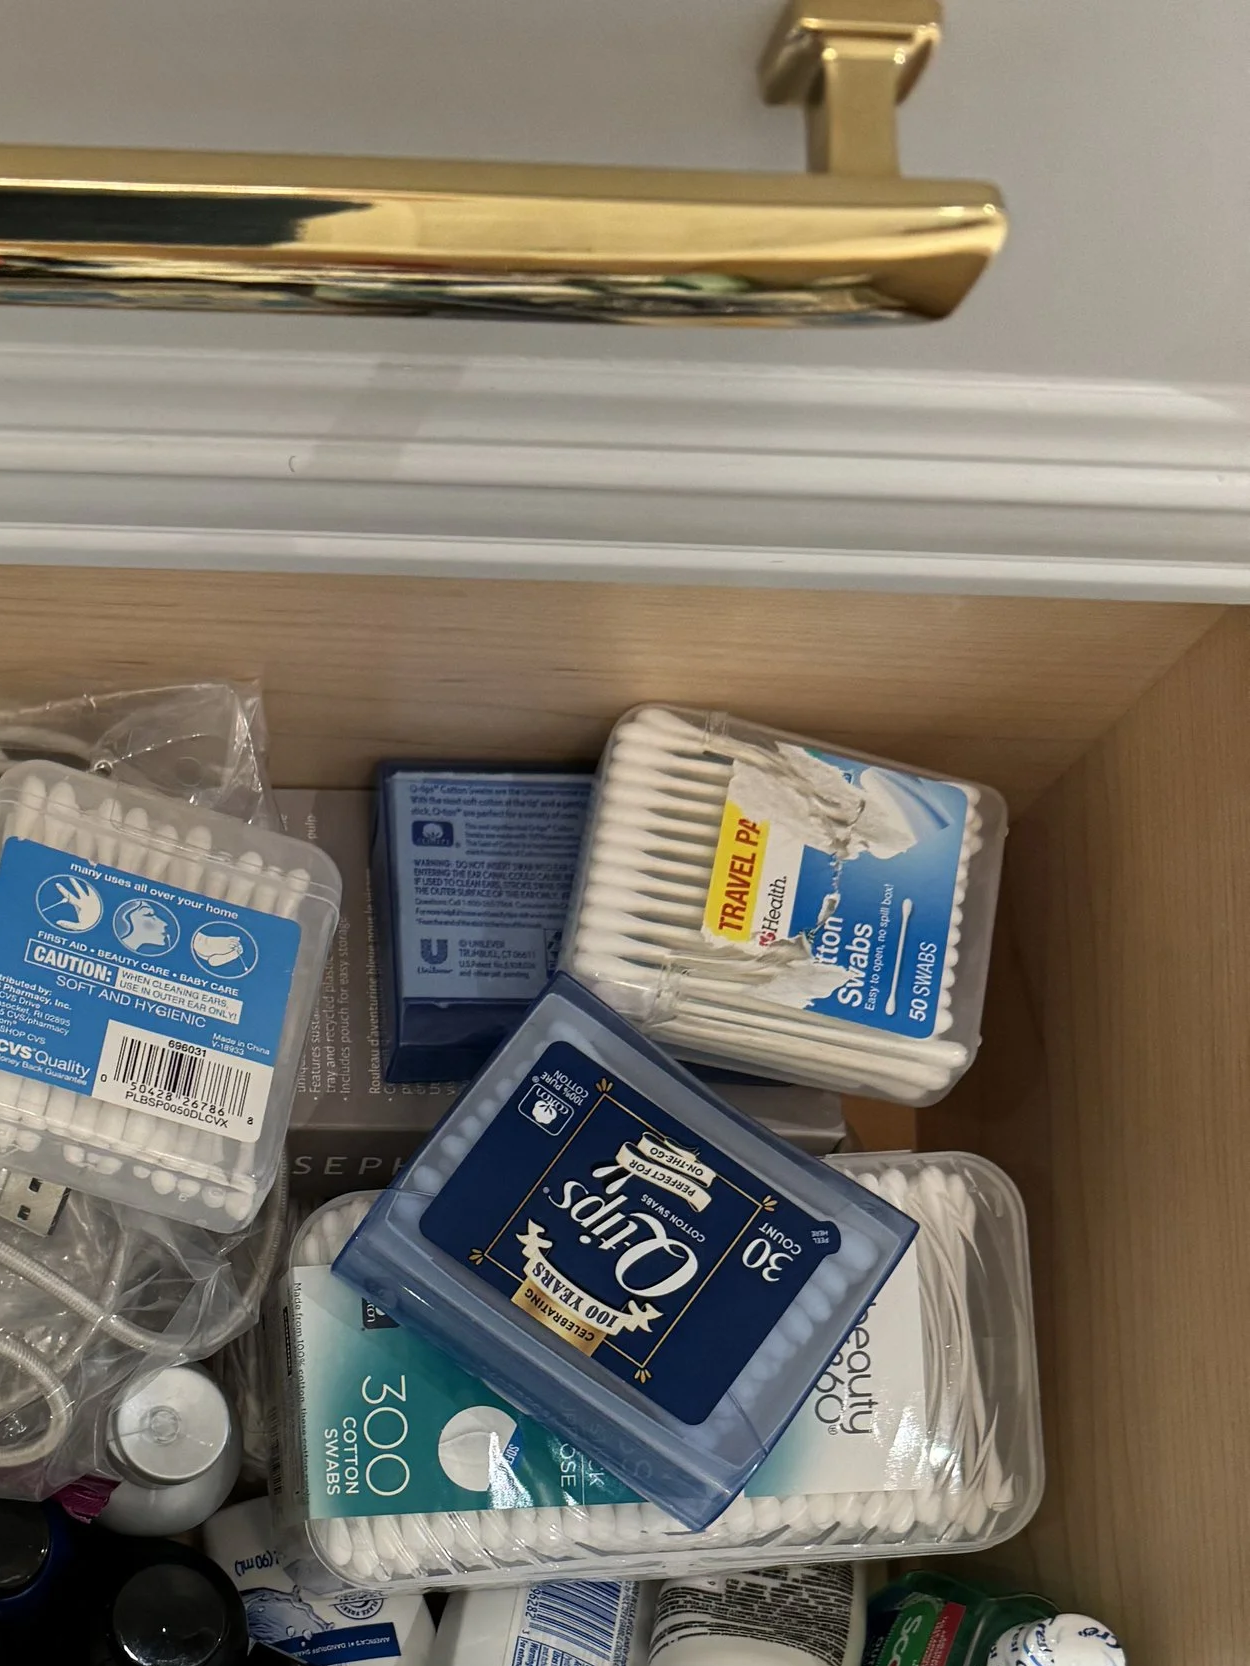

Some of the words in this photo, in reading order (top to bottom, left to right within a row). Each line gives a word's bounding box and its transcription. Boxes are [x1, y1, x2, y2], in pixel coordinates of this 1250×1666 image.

[735, 817, 762, 846] PA
[69, 862, 102, 881] many
[103, 872, 132, 889] uses
[133, 881, 148, 893] all
[148, 887, 176, 902] over
[176, 895, 204, 911] your
[204, 902, 239, 920] home
[718, 850, 756, 933] TRAVEL
[881, 883, 895, 905] box!
[878, 906, 892, 927] spill
[338, 915, 349, 956] storage
[876, 928, 887, 942] no
[31, 945, 114, 983] CAUTION:
[36, 930, 68, 947] FIRST
[68, 939, 88, 952] AID
[96, 948, 140, 968] BEAUTY
[140, 962, 170, 977] CARE
[178, 972, 209, 988] BABY
[209, 981, 239, 997] CARE
[338, 960, 350, 984] easy
[836, 921, 875, 1007] Swabs
[871, 944, 886, 972] open,
[911, 941, 937, 996] SWABS
[339, 986, 349, 1002] for
[869, 972, 880, 983] to
[55, 975, 96, 996] SOFT
[98, 987, 132, 1007] AND
[133, 998, 207, 1029] HYGIENIC
[864, 985, 879, 1011] Easy
[908, 997, 928, 1021] 50
[339, 1006, 350, 1042] pouch
[32, 1050, 91, 1079] Quality
[167, 1040, 207, 1058] 696031
[339, 1046, 350, 1093] Includes
[369, 1049, 380, 1093] Rouleau
[129, 1082, 173, 1102] 50428
[182, 1097, 225, 1116] 26786
[628, 1156, 652, 1177] FOR
[648, 1140, 704, 1183] ON-THE-GO
[651, 1166, 696, 1201] PERFECT
[638, 1192, 672, 1219] SWABS
[549, 1178, 700, 1296] Q-tips
[668, 1213, 708, 1243] COTTON
[757, 1219, 804, 1256] COUNT
[741, 1236, 793, 1283] 30
[526, 1260, 589, 1310] YEARS
[519, 1287, 598, 1343] CELEBRATING
[583, 1300, 618, 1331] 100
[359, 1373, 412, 1496] 300
[322, 1428, 341, 1495] SWABS
[340, 1416, 360, 1494] COTTON
